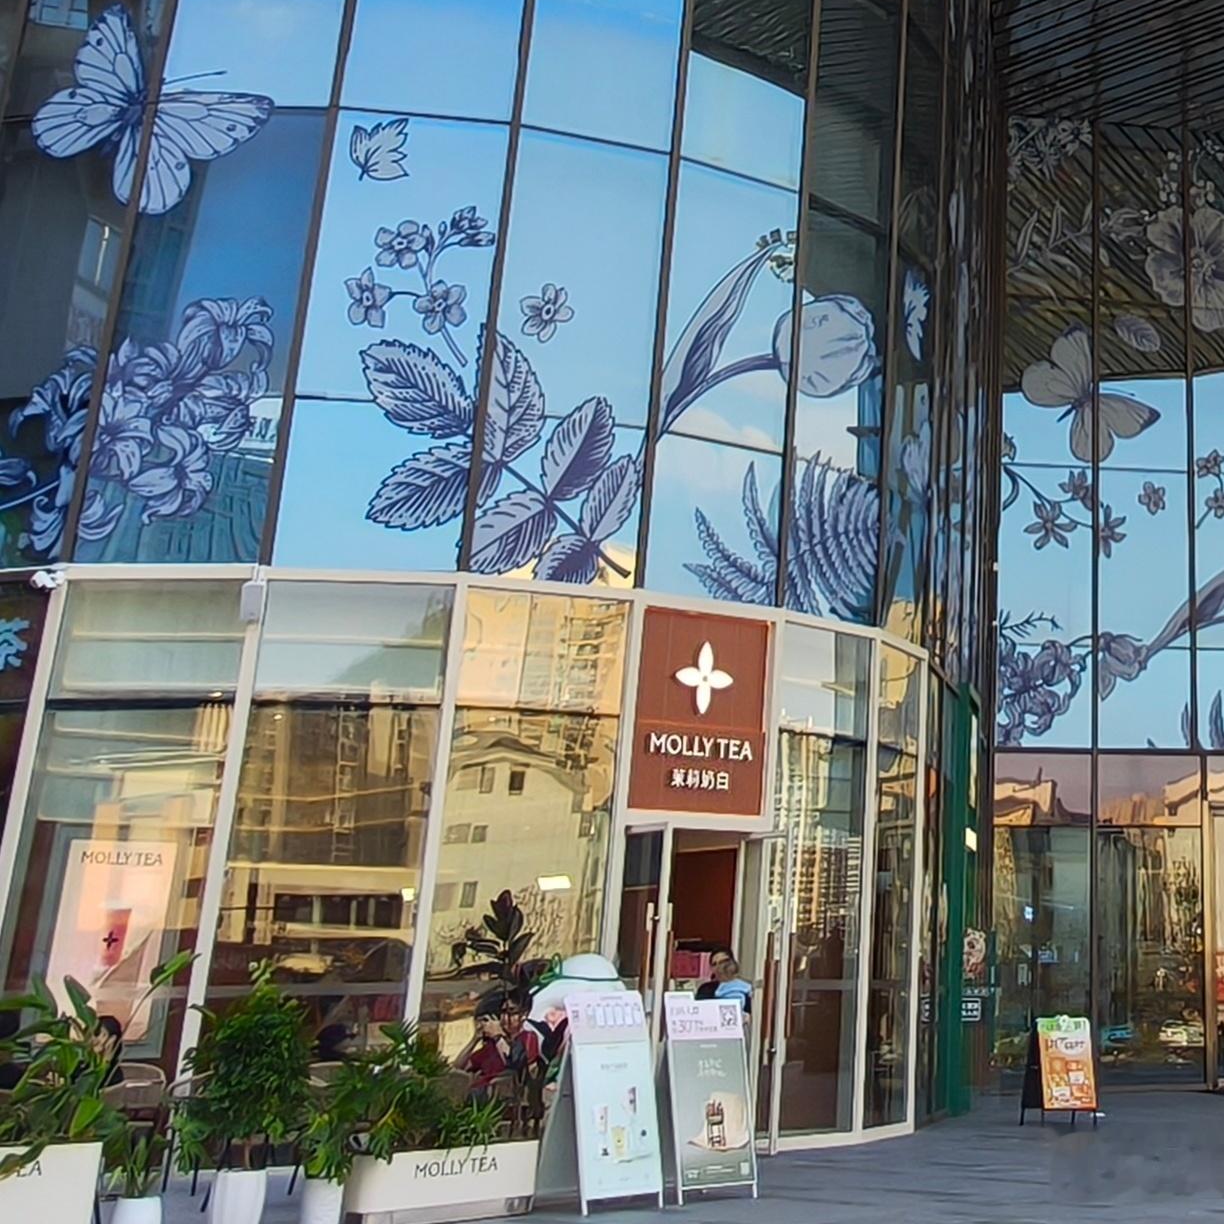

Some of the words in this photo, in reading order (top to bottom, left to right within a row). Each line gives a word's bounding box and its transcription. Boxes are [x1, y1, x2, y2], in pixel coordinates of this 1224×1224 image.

[649, 732, 714, 757] MOLLY
[716, 738, 753, 761] TEA
[670, 768, 729, 790] 茉莉奶白
[80, 851, 132, 866] MOLLY
[135, 852, 162, 867] TEA
[414, 1159, 467, 1178] MOLLY
[471, 1156, 498, 1173] TEA
